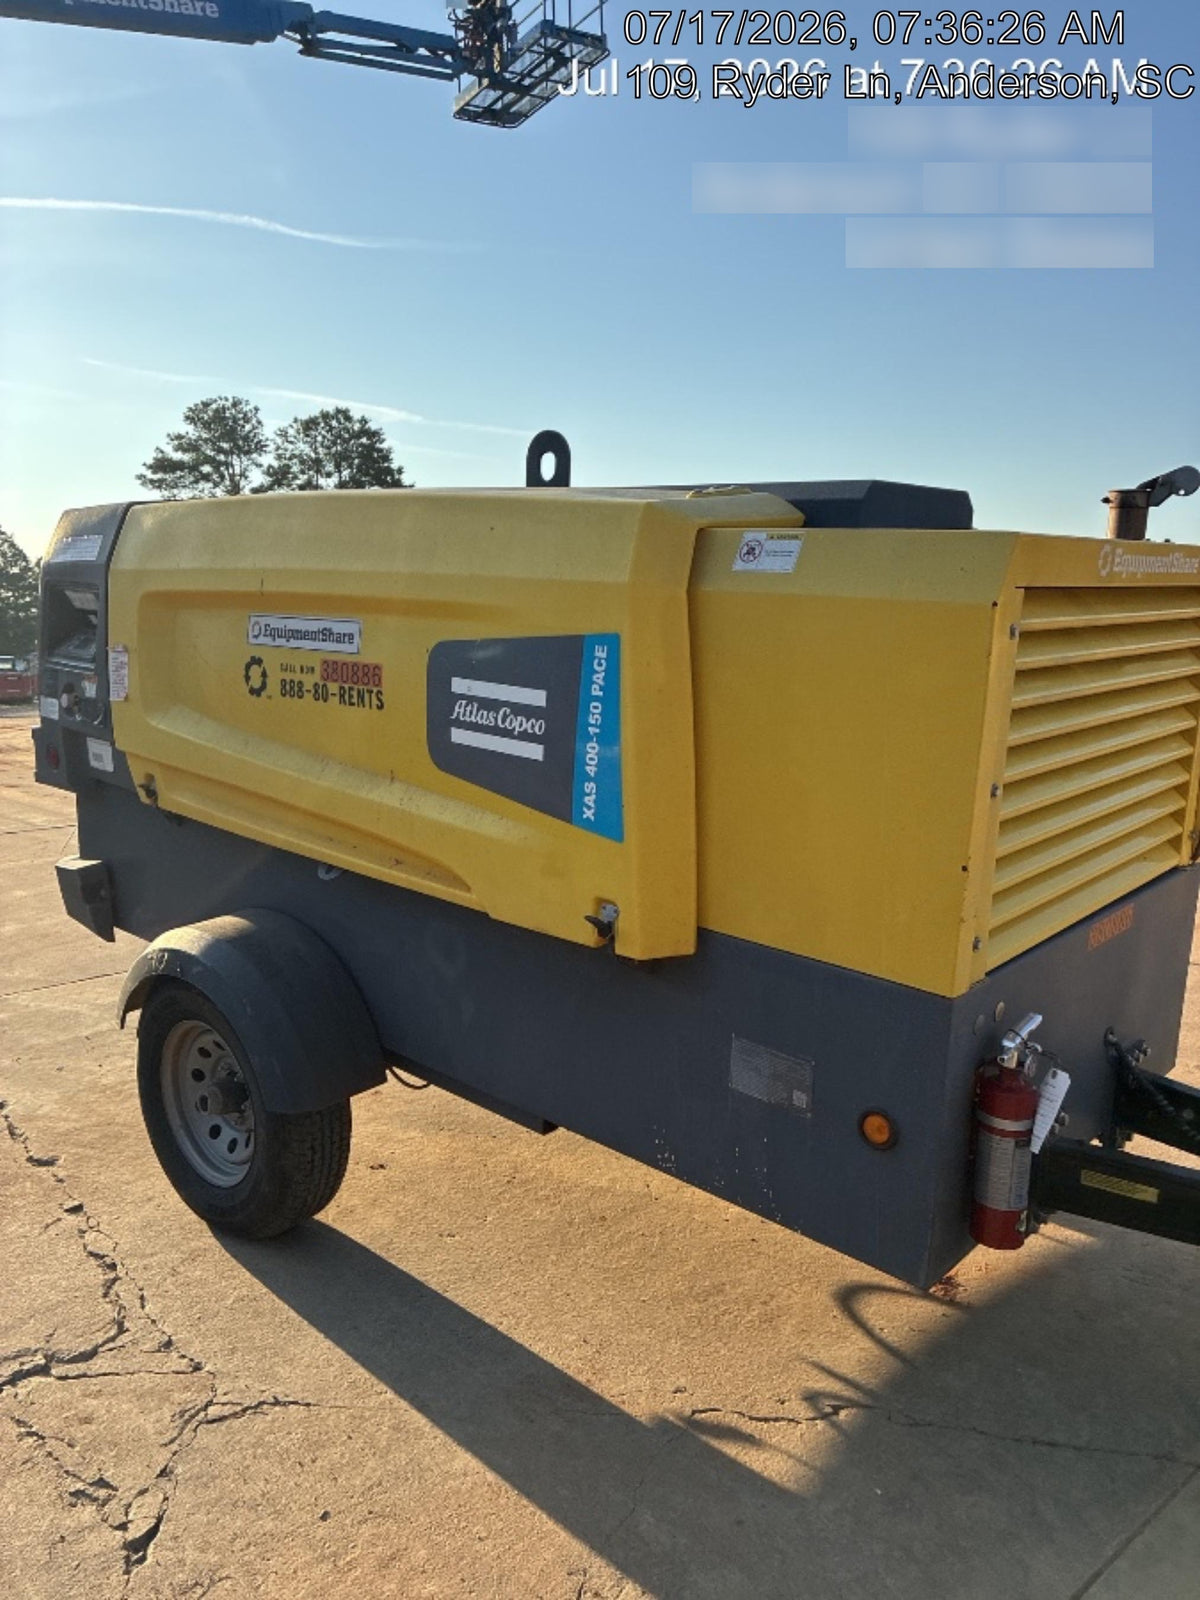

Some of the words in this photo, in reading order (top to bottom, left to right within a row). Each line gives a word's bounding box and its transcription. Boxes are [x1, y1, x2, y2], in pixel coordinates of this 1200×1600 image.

[262, 623, 355, 645] EquipmentShare
[321, 660, 382, 687] 380886
[591, 644, 608, 697] PACE
[280, 678, 385, 711] 888-80-RENTS
[584, 701, 602, 777] 400-150
[582, 782, 597, 821] XAS
